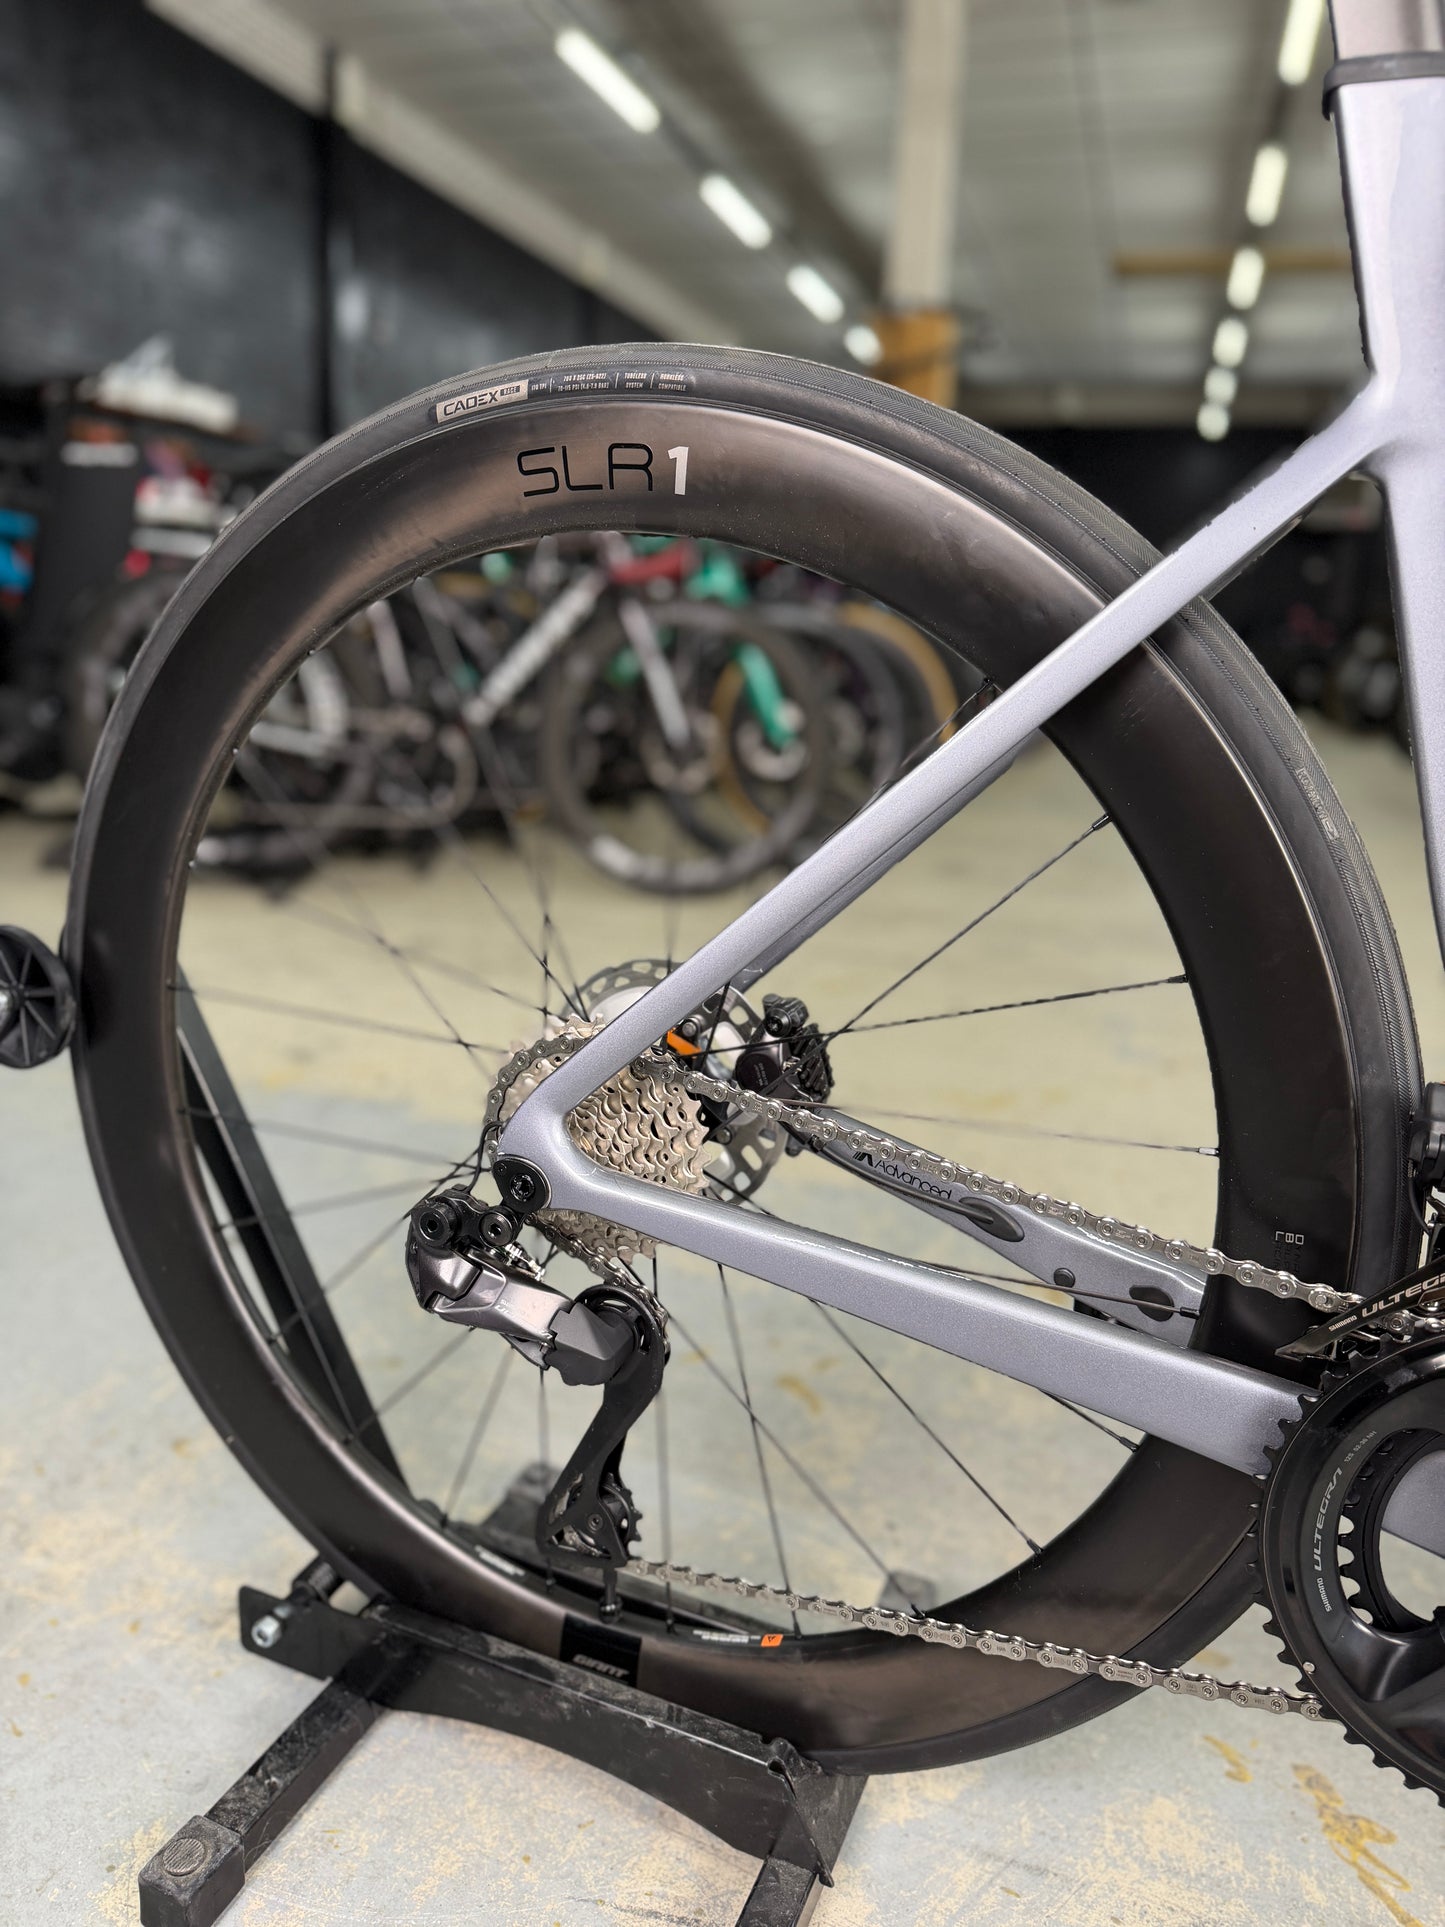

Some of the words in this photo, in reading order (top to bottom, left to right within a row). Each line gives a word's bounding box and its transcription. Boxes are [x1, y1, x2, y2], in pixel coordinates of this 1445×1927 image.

[443, 390, 499, 416] CADEX
[502, 386, 518, 396] RACE
[658, 383, 687, 392] COMPATIBLE
[874, 1159, 952, 1199] Advanced
[1328, 1315, 1357, 1331] SHIMANO
[1313, 1467, 1343, 1572] ULTEGRA
[1317, 1577, 1332, 1612] SHIMANO
